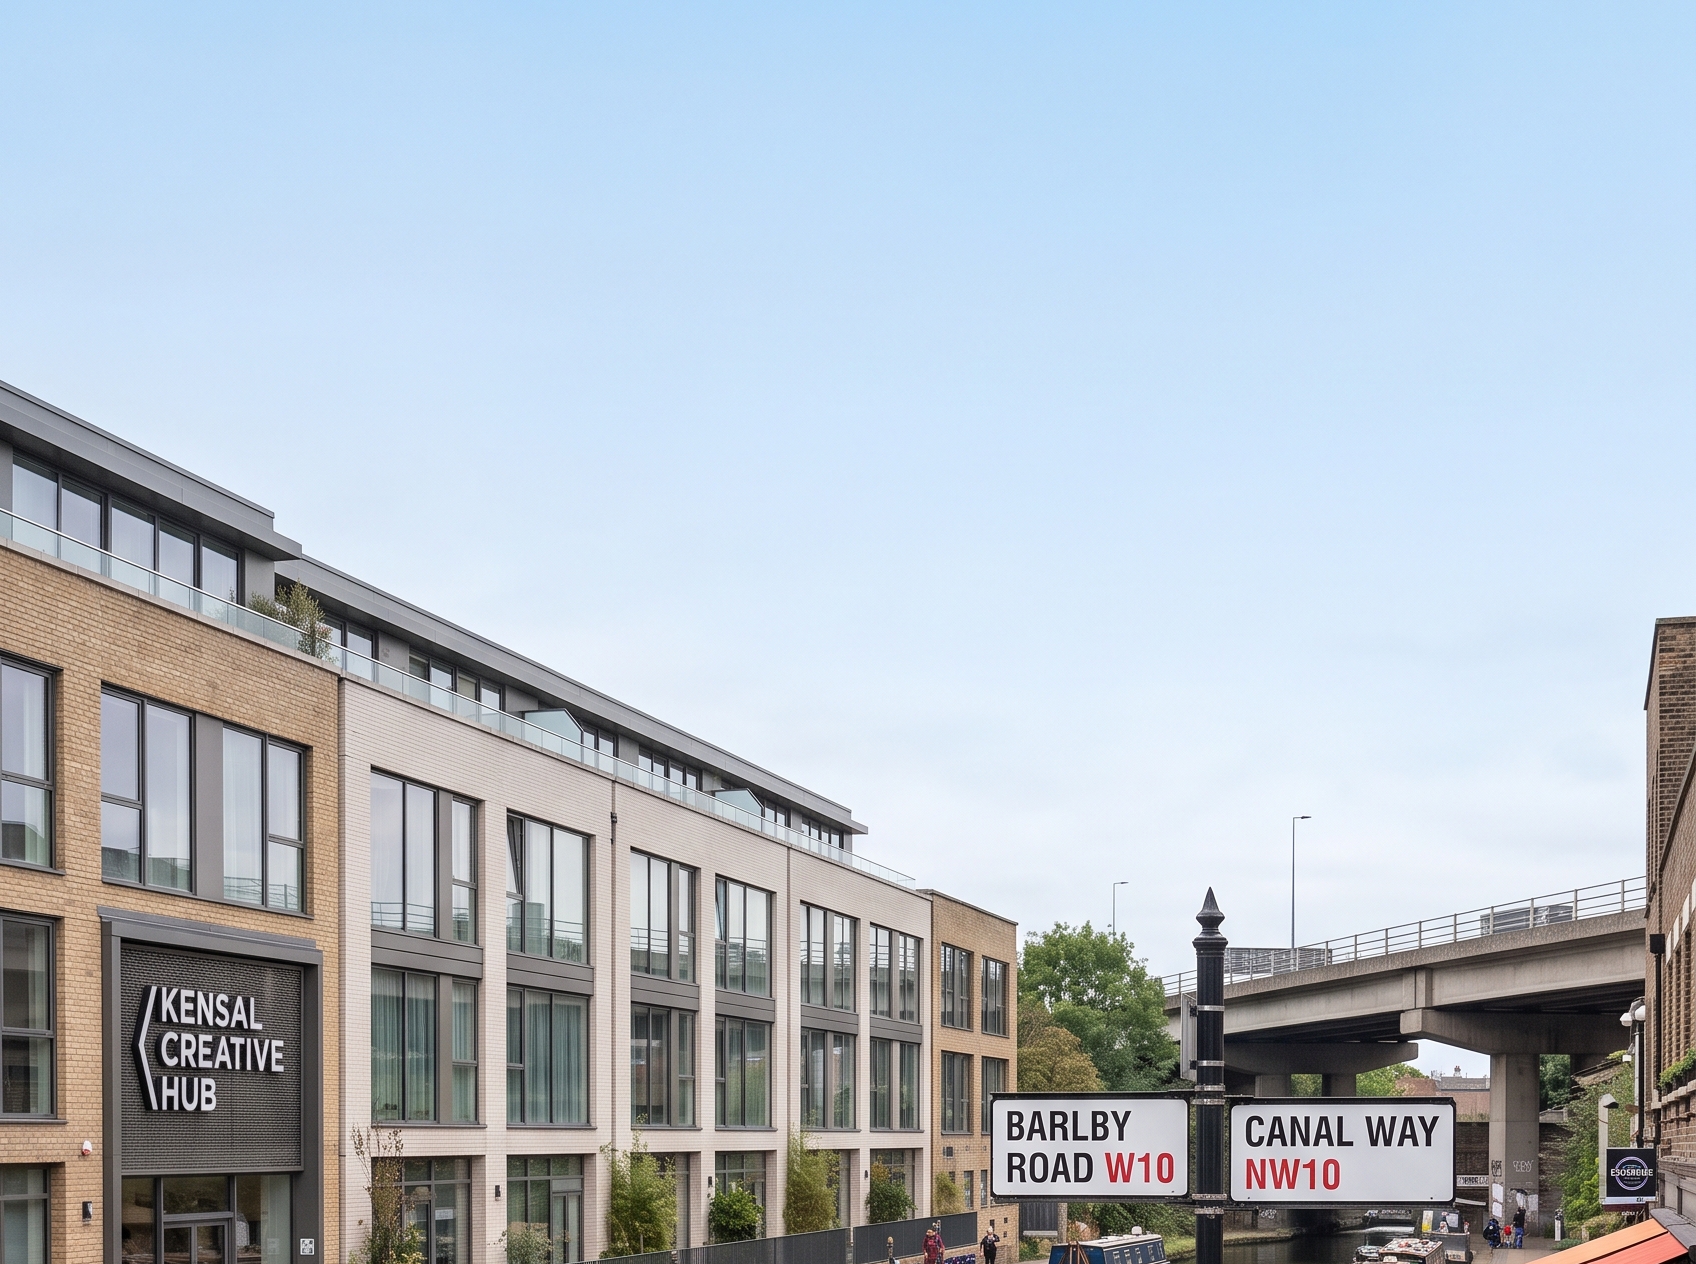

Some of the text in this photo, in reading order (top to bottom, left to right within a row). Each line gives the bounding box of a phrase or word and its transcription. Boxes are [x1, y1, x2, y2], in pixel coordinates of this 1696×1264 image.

[161, 986, 263, 1030] KENSAL
[161, 1031, 285, 1073] CREATIVE
[161, 1076, 217, 1112] HUB
[1006, 1110, 1132, 1142] BARLBY
[1245, 1115, 1440, 1147] CANAL WAY
[1007, 1152, 1175, 1184] ROAD W10
[1245, 1158, 1341, 1191] NW10
